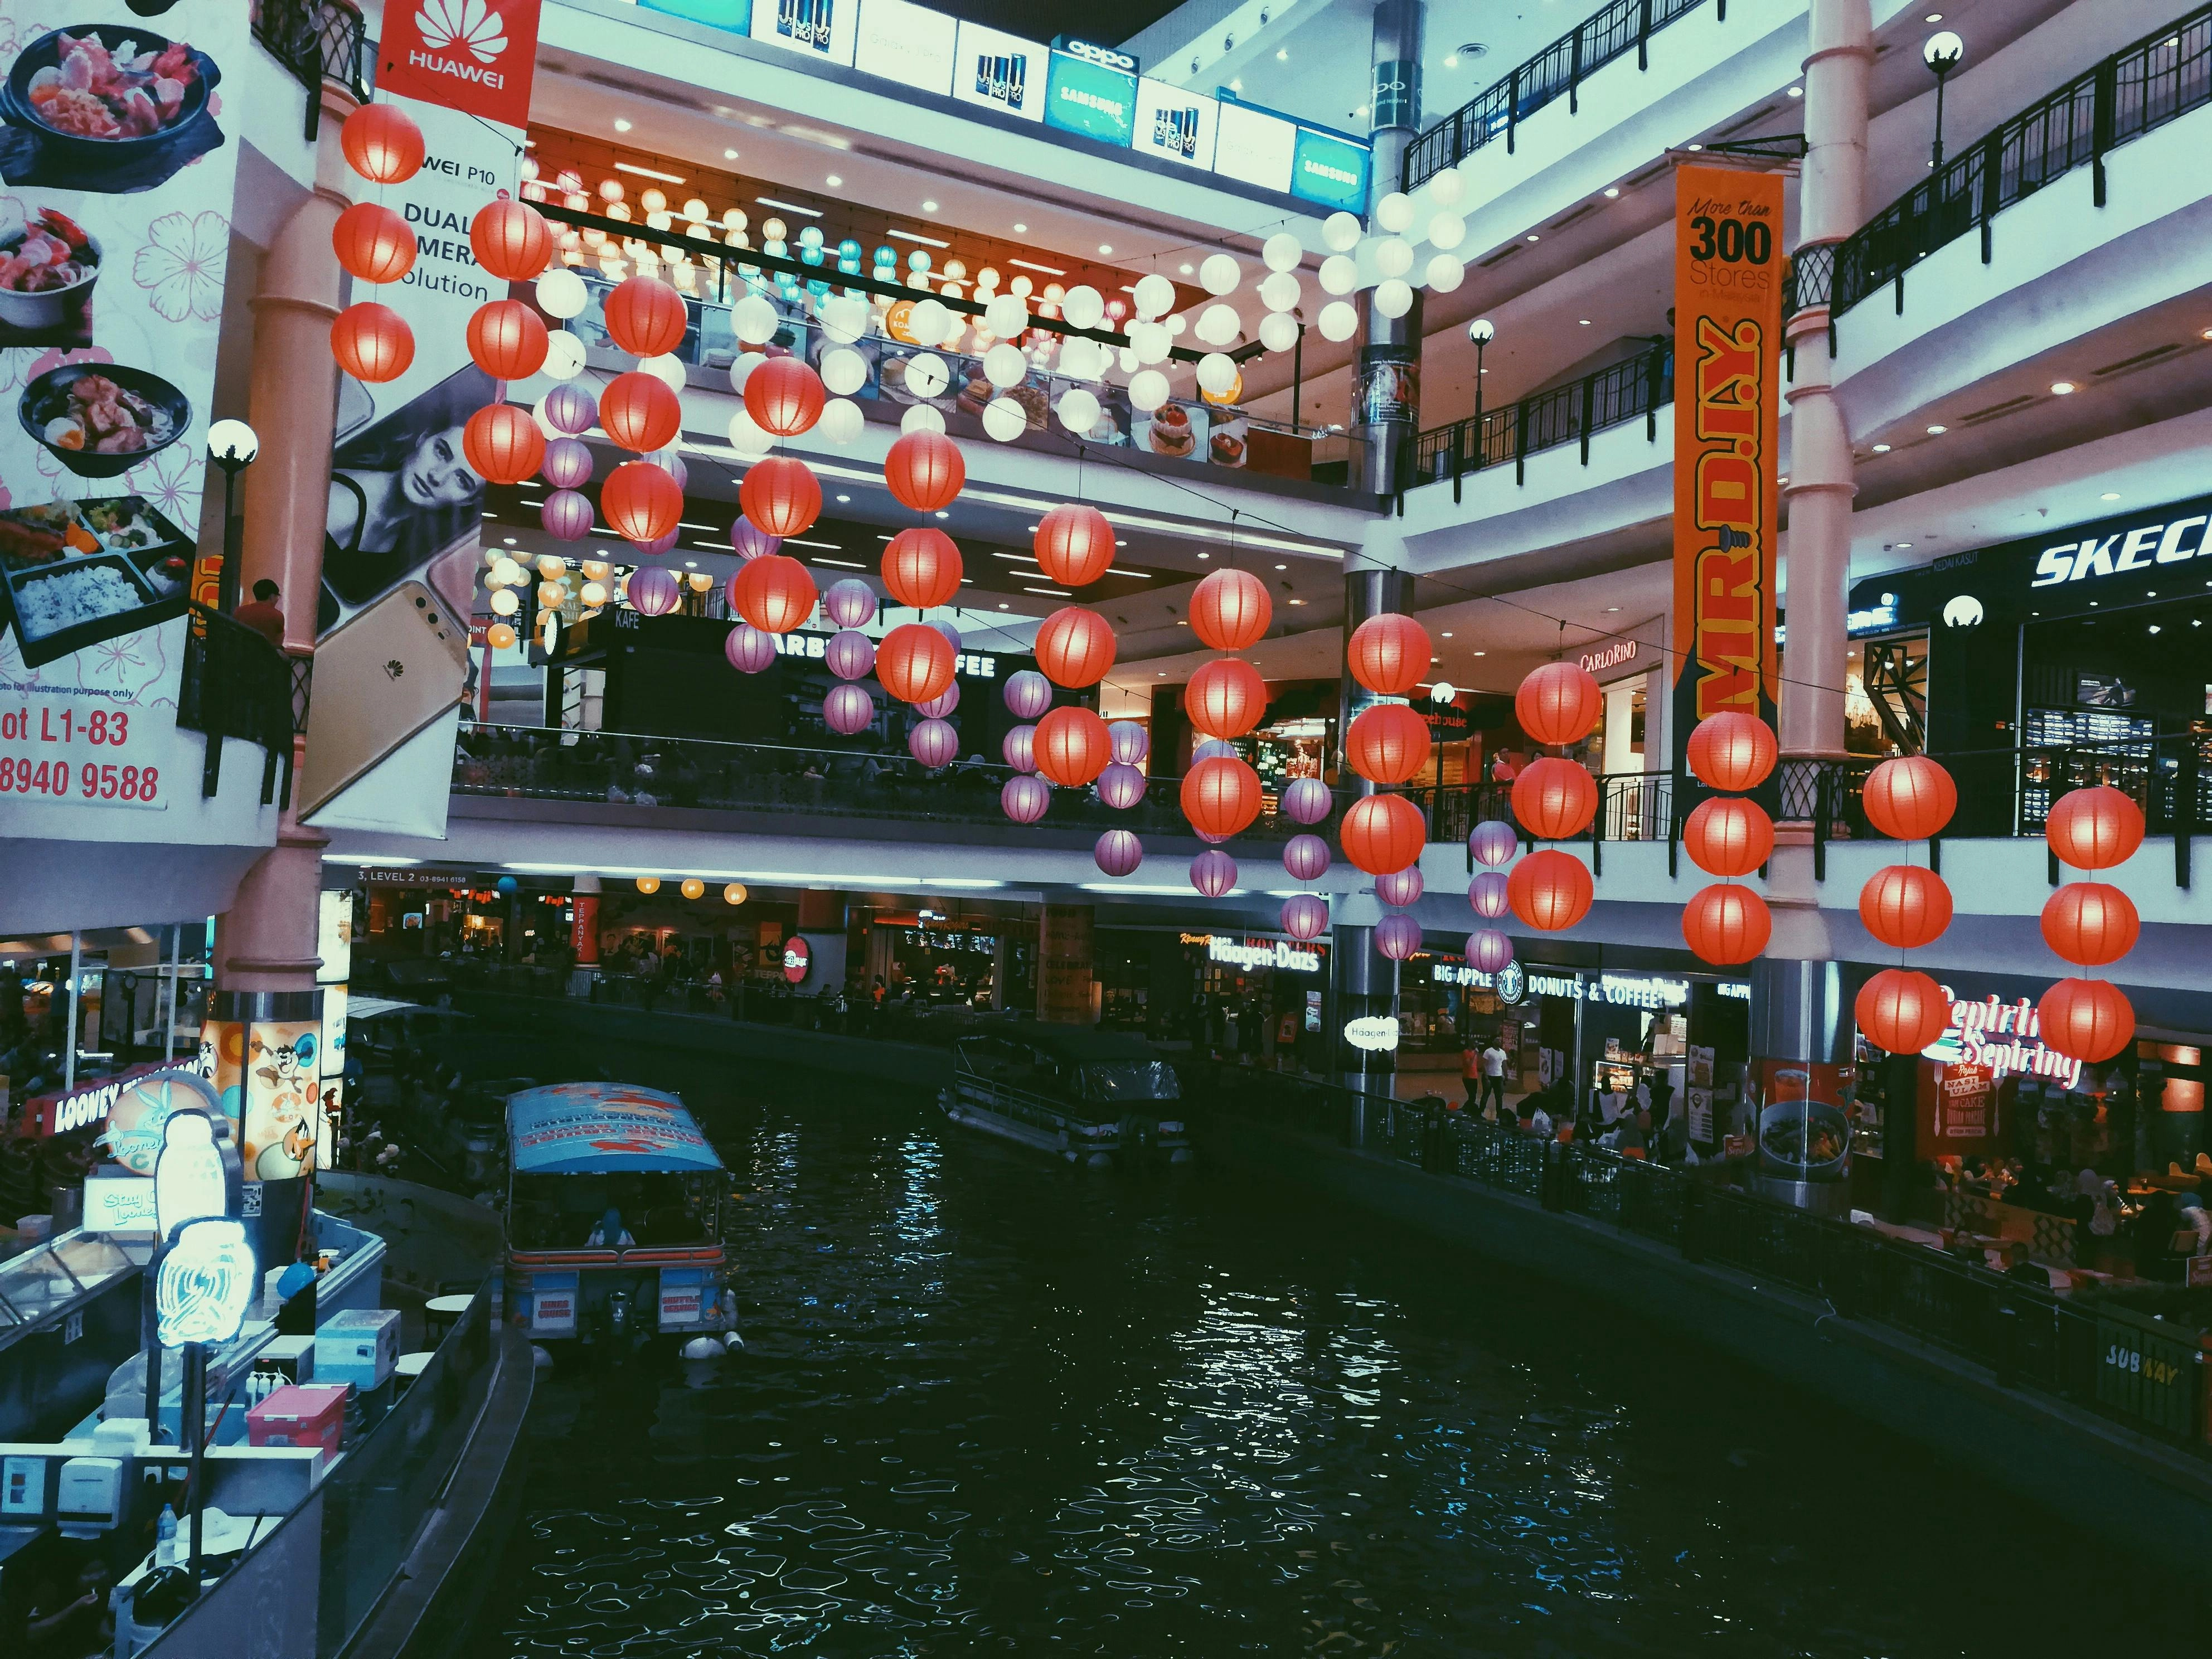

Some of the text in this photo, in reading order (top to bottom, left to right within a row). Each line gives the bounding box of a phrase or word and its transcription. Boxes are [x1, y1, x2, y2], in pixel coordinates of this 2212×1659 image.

[409, 49, 505, 90] HUAWEI
[421, 157, 460, 177] WEI
[468, 166, 496, 186] P10
[1304, 159, 1358, 186] SAMSUNG
[1687, 197, 1772, 217] More than
[1690, 216, 1772, 265] 300
[401, 266, 488, 302] olution
[1690, 259, 1771, 290] Stores
[1955, 551, 1980, 567] KASUT
[2031, 513, 2212, 588] SKEC
[468, 625, 487, 635] OINT
[615, 610, 640, 629] KAFE
[73, 685, 110, 697] purpose
[113, 688, 134, 700] only
[41, 707, 129, 746] L1-83
[0, 756, 159, 802] 8940 9588
[370, 871, 405, 882] LEVEL
[408, 873, 415, 882] 2
[576, 902, 585, 958] TEPPANYAKI
[754, 968, 786, 982] TEPPA
[1434, 964, 1492, 988] BIG APPLE
[1528, 975, 1583, 1000] DONUTS
[1588, 982, 1600, 1002] &
[1604, 984, 1658, 1009] COFFEE
[1958, 1064, 1978, 1077] Rojak
[1947, 1078, 1977, 1088] NASI
[1952, 1083, 1987, 1095] ULAM
[54, 1083, 120, 1133] LOONEY
[1960, 1096, 1985, 1108] CAKE
[537, 1309, 571, 1319] CRUISE
[540, 1299, 569, 1310] MINES
[663, 1304, 699, 1313] SERVICE
[2106, 1343, 2179, 1387] SUBWAY
